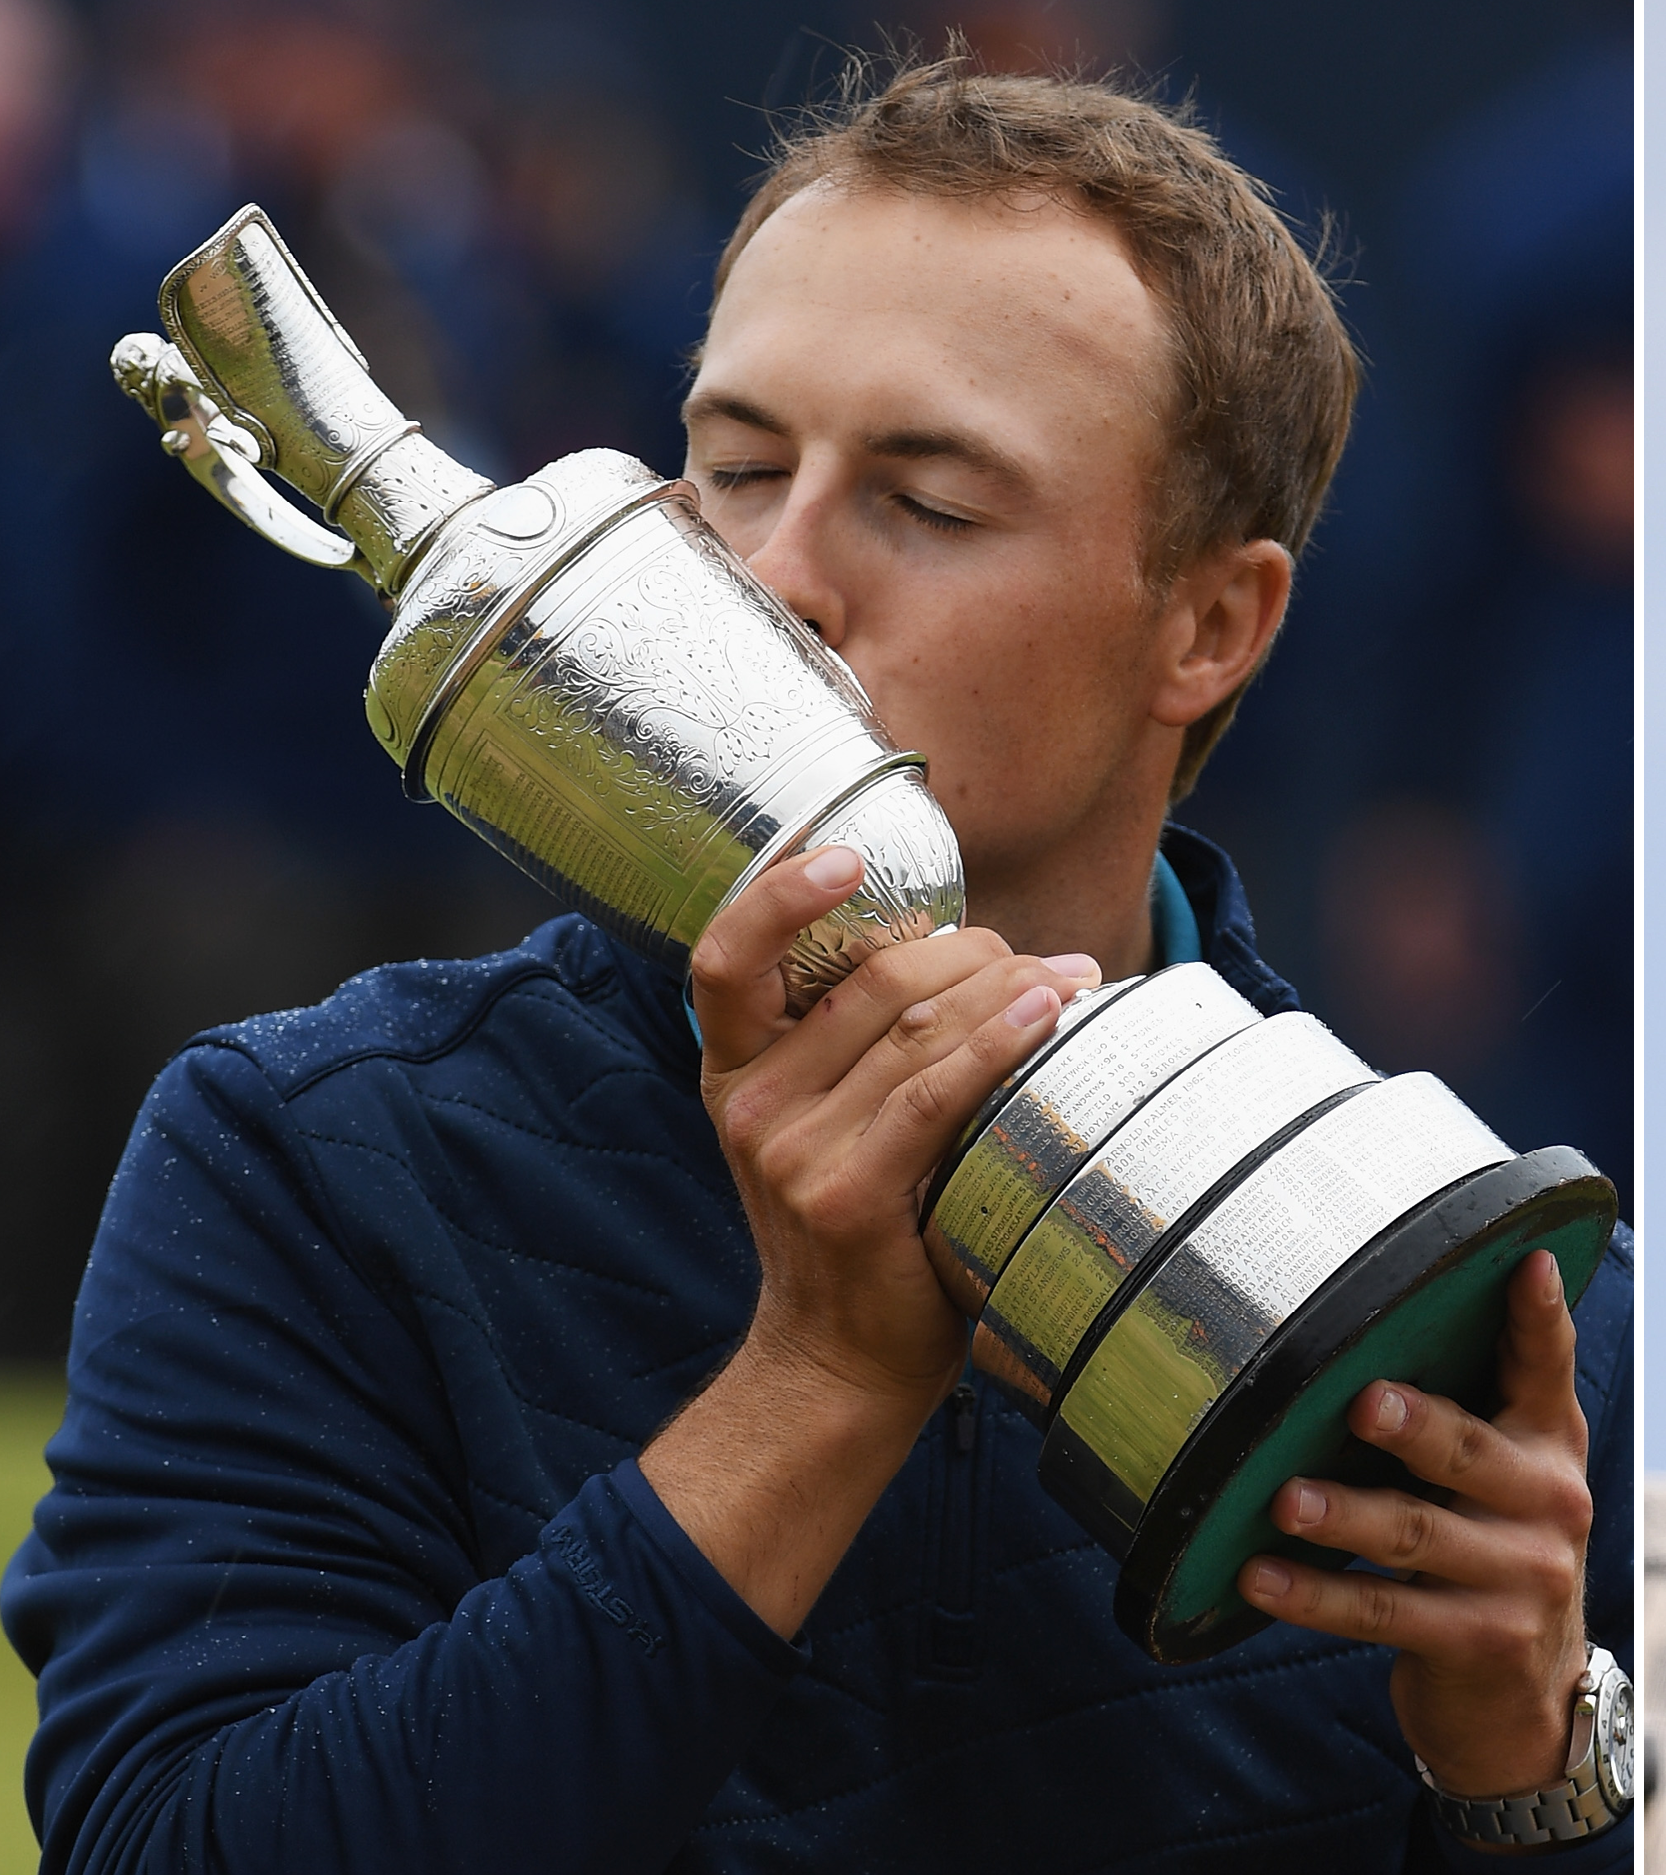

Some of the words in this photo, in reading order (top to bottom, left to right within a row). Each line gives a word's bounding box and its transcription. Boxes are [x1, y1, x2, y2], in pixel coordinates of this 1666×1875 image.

[1004, 1184, 1027, 1212] JAMES
[1071, 1091, 1113, 1132] MUIRFIELD
[1116, 1069, 1137, 1088] 300
[1138, 1034, 1184, 1071] STROKES
[1019, 1092, 1036, 1109] AT
[1033, 1053, 1075, 1094] HOYLAKE
[1028, 1100, 1046, 1119] AT
[1041, 1057, 1090, 1104] PRESTWICK
[1085, 1040, 1109, 1062] 300
[1037, 1110, 1056, 1128] AT
[1050, 1068, 1098, 1114] SANDWICH
[1067, 1138, 1084, 1156] AT
[1080, 1099, 1124, 1141] HOYLAKE
[1125, 1078, 1146, 1097] 312
[1147, 1042, 1193, 1079] STROKES
[1101, 1125, 1145, 1167] ARNOLD
[1142, 1091, 1183, 1128] PALMER
[1181, 1070, 1207, 1093] 1962
[1048, 1120, 1064, 1136] AT
[1069, 1178, 1112, 1225] STROKES
[1112, 1150, 1137, 1174] BOB
[1134, 1110, 1180, 1153] CHARLES
[1177, 1090, 1204, 1113] 1963
[1202, 1077, 1219, 1092] AT
[1120, 1154, 1151, 1184] TONY
[1147, 1127, 1180, 1158] LEMA
[1141, 1172, 1172, 1203] JACK
[1168, 1131, 1217, 1175] NICKLAUS
[1217, 1112, 1242, 1133] 1966
[1154, 1169, 1197, 1211] ROBERTO
[1196, 1156, 1211, 1170] DE
[1208, 1126, 1246, 1159] VICENZO
[1364, 1160, 1392, 1181] JOHN
[1130, 1162, 1162, 1194] PETER
[1164, 1191, 1193, 1220] GARY
[1190, 1157, 1228, 1192] PLAYER
[1251, 1126, 1266, 1138] AT
[1184, 1232, 1206, 1255] 1976
[1202, 1224, 1215, 1236] AT
[1211, 1202, 1237, 1228] ROYAL
[1232, 1172, 1269, 1206] BIRKDALE
[1191, 1239, 1213, 1262] 1977
[1210, 1229, 1222, 1242] AT
[1220, 1187, 1266, 1232] TURNBERRY
[1287, 1142, 1318, 1168] STROKES
[1201, 1242, 1223, 1265] 1978
[1218, 1232, 1233, 1246] AT
[1238, 1191, 1276, 1227] ANDREWS
[1277, 1172, 1297, 1190] 281
[1294, 1148, 1327, 1176] STROKES
[1221, 1237, 1241, 1257] 1979
[1238, 1228, 1251, 1240] AT
[1255, 1198, 1282, 1224] ANNES
[1285, 1179, 1305, 1196] 283
[1301, 1154, 1334, 1182] STROKES
[1372, 1170, 1395, 1187] TOM
[988, 1208, 1014, 1242] STROKES
[1212, 1256, 1236, 1281] 1980
[1233, 1245, 1247, 1260] AT
[1244, 1204, 1290, 1249] MUIRFIELD
[1292, 1185, 1311, 1203] 271
[1308, 1161, 1342, 1189] STROKES
[1220, 1265, 1242, 1288] 1981
[1241, 1252, 1255, 1266] AT
[1252, 1214, 1294, 1255] SANDWICH
[1299, 1191, 1320, 1210] 276
[1315, 1167, 1350, 1196] STROKES
[1228, 1271, 1251, 1295] 1982
[1248, 1258, 1263, 1273] AT
[1261, 1226, 1296, 1260] TROON
[1306, 1199, 1327, 1217] 284
[1322, 1174, 1357, 1203] STROKES
[1235, 1280, 1257, 1302] 1983
[1253, 1269, 1267, 1283] AT
[1262, 1248, 1288, 1273] ROYAL
[1283, 1221, 1316, 1253] BIRKDALE
[1314, 1206, 1334, 1224] 275
[1330, 1181, 1364, 1210] STROKES
[1255, 1274, 1275, 1294] 1984
[1271, 1265, 1285, 1278] AT
[1320, 1213, 1340, 1231] 276
[1337, 1188, 1370, 1216] STROKES
[1256, 1300, 1279, 1323] 1986
[1277, 1286, 1292, 1301] AT
[1289, 1243, 1337, 1289] TURNBERRY
[1351, 1202, 1386, 1230] STROKES
[1008, 1295, 1022, 1312] AT
[1016, 1249, 1053, 1299] HOYLAKE
[1019, 1300, 1034, 1319] AT
[1038, 1328, 1051, 1345] AT
[1046, 1273, 1087, 1330] MUIRFIELD
[1200, 1341, 1229, 1373] SANDY
[1224, 1318, 1248, 1343] LYLE
[1248, 1293, 1270, 1317] 1985
[1269, 1279, 1284, 1294] AT
[1282, 1238, 1326, 1280] SANDWICH
[1327, 1220, 1347, 1237] 282
[1344, 1195, 1378, 1223] STROKES
[1263, 1307, 1285, 1330] 1987
[1284, 1293, 1300, 1308] AT
[1296, 1250, 1344, 1296] MUIRFIELD
[1342, 1233, 1363, 1251] 279
[1360, 1209, 1393, 1236] STROKES
[1029, 1311, 1043, 1330] AT
[1044, 1342, 1057, 1358] AT
[1058, 1346, 1069, 1360] AT
[1064, 1321, 1085, 1349] ROYAL
[1081, 1278, 1115, 1323] BIRKDALE
